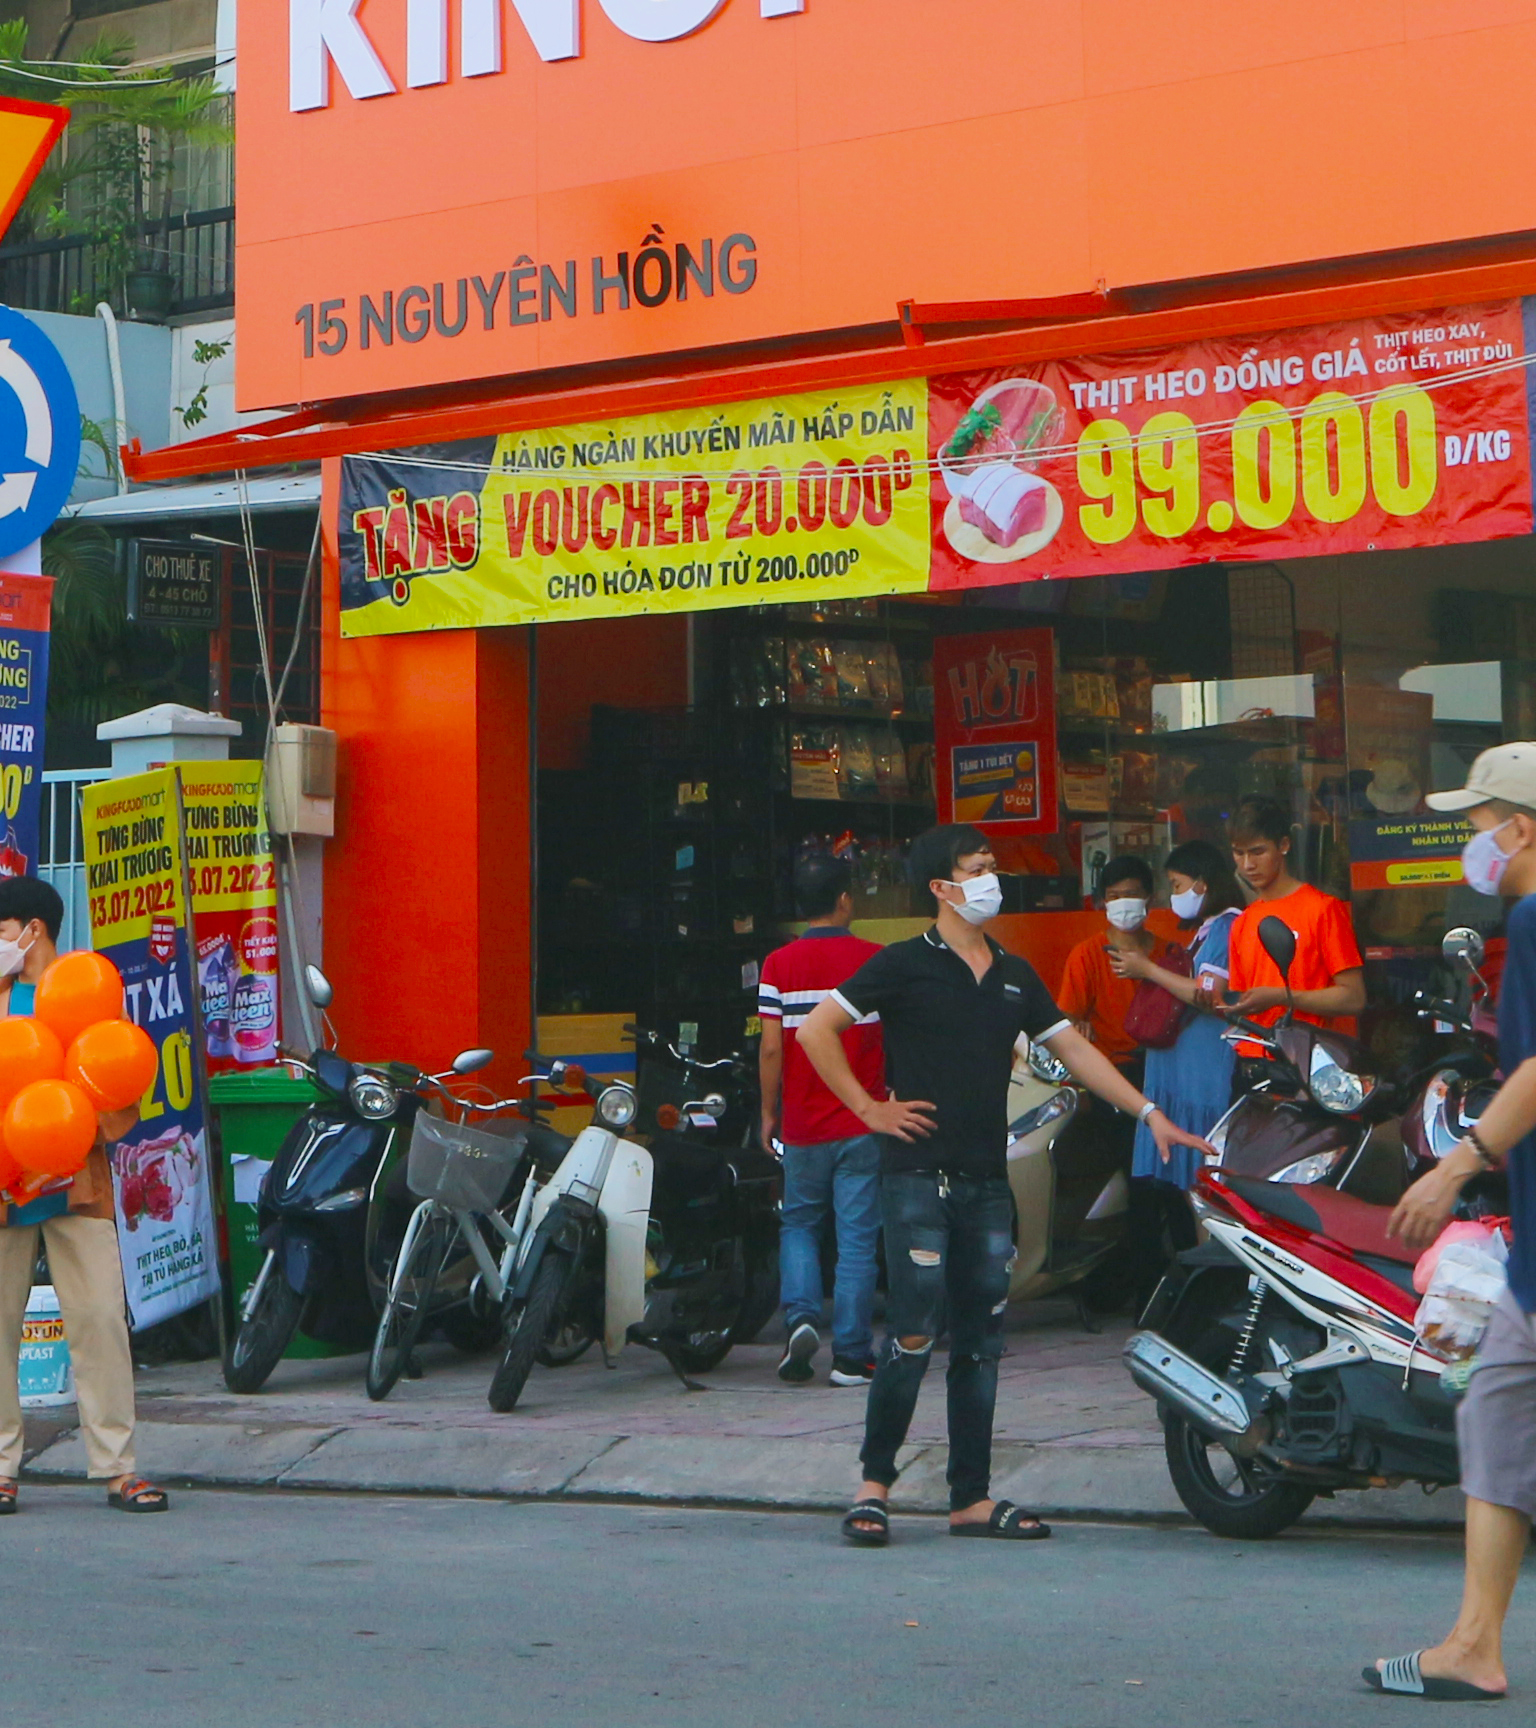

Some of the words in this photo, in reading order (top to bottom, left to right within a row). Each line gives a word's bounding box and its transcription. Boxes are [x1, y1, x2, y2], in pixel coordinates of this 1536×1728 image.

[294, 298, 348, 360] 15
[359, 254, 577, 350] NGUYÊN
[592, 224, 758, 315] HỒNG
[1373, 329, 1409, 352] THỊT
[1411, 327, 1446, 347] HEO
[1448, 321, 1488, 343] XAY,
[1373, 348, 1402, 374] CỐT
[1404, 344, 1442, 371] LẾT,
[1443, 343, 1481, 368] THỊT
[1483, 335, 1514, 361] ĐÙI
[1069, 378, 1140, 415] THỊT
[1144, 367, 1208, 403] HEO
[1212, 347, 1306, 398] ĐỒNG
[1311, 337, 1370, 386] GIÁ
[502, 442, 566, 474] HÀNG
[572, 429, 638, 469] NGÀN
[643, 413, 742, 461] KHUYẾN
[748, 411, 796, 449] MÃI
[802, 400, 854, 444] HẤP
[860, 391, 915, 438] DẪN
[1443, 428, 1513, 468] Đ/KG
[1076, 383, 1438, 545] 99.000
[502, 479, 711, 559] VOUCHER
[145, 555, 168, 579] CHO
[199, 558, 212, 583] XE
[354, 488, 480, 607] TẶNG
[149, 586, 156, 599] 4
[165, 588, 180, 601] 45
[547, 573, 598, 602] CHO
[602, 560, 654, 597] HÓA
[658, 559, 713, 592] ĐƠN
[717, 549, 751, 586] TỪ
[947, 644, 1039, 722] HOT
[96, 823, 129, 856] TƯNG
[132, 813, 165, 848] BỪNG
[184, 804, 220, 830] TƯNG
[223, 799, 259, 829] BỪNG
[90, 858, 119, 890] KHAI
[147, 961, 185, 1023] XÁ
[235, 989, 272, 1008] Max
